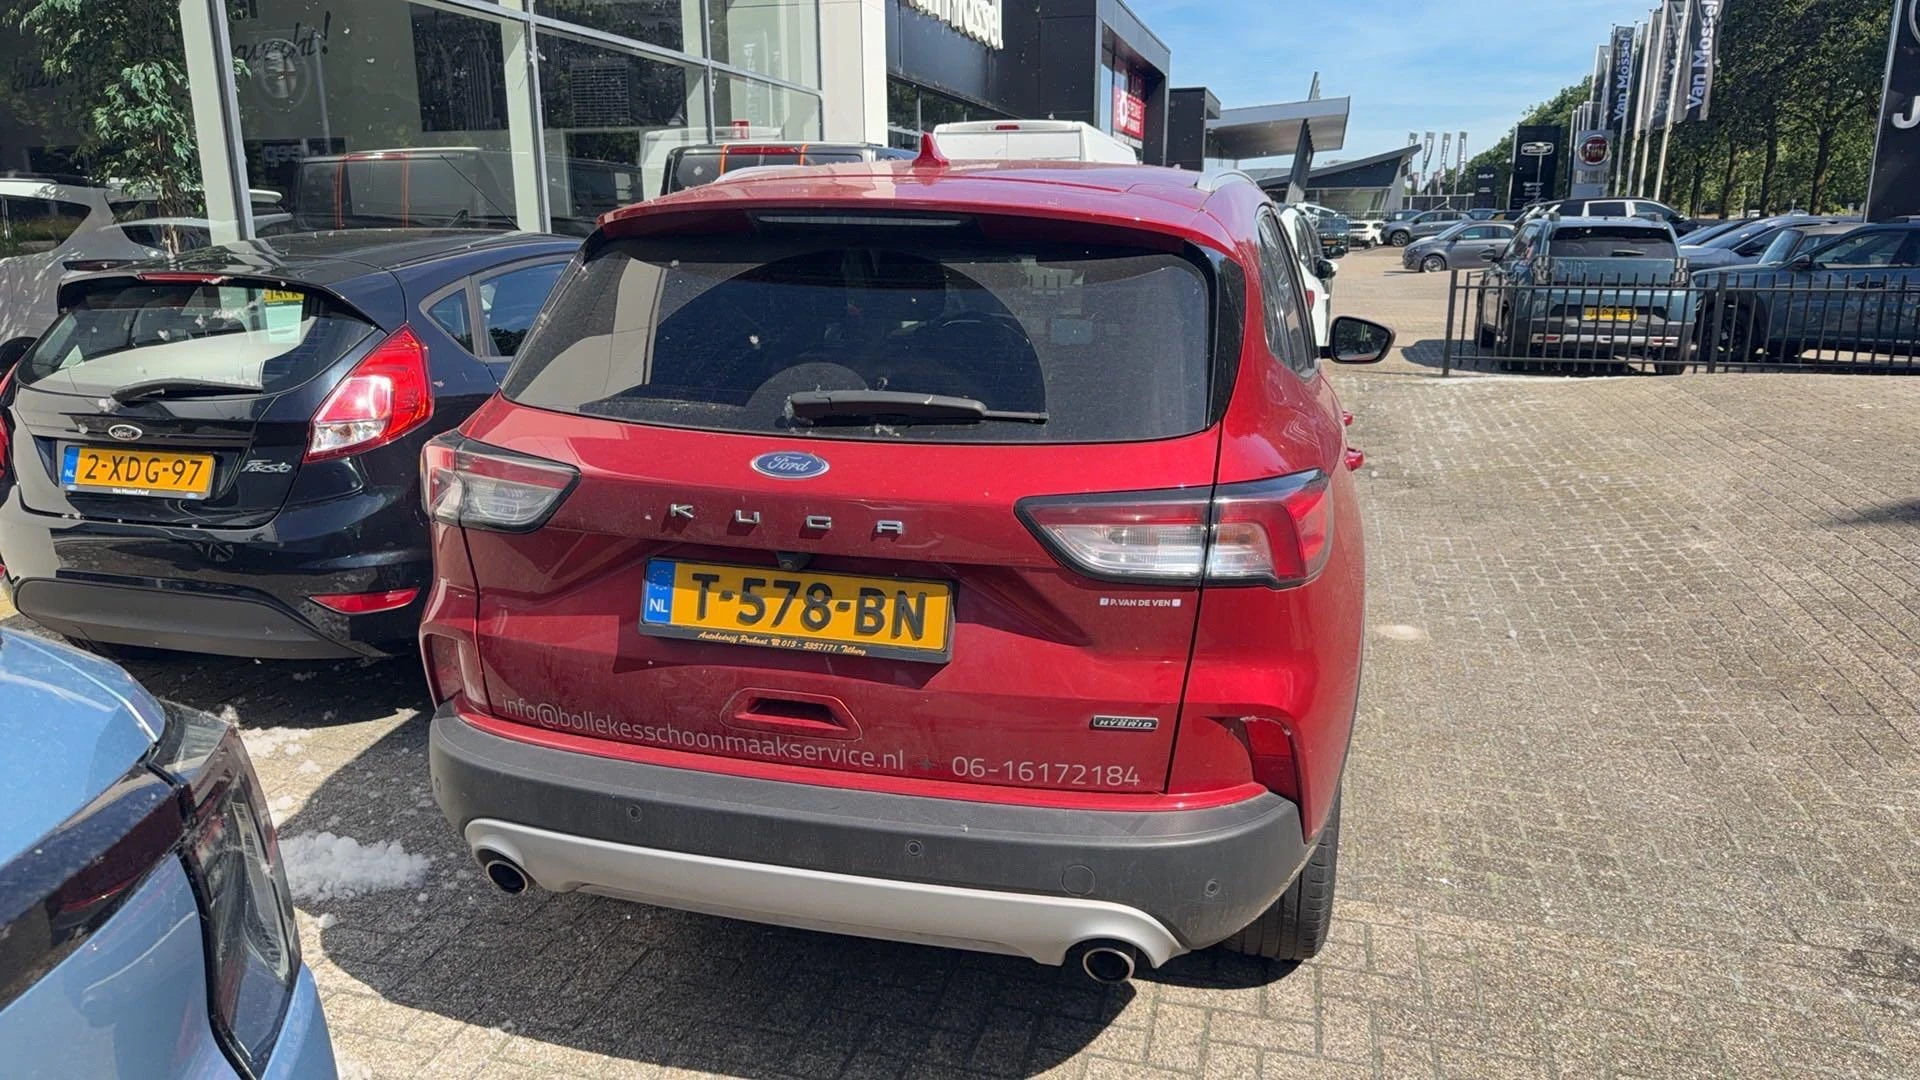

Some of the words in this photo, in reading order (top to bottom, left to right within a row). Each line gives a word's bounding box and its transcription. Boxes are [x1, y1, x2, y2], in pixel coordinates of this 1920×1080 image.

[1692, 0, 1719, 68] Mossel
[1616, 37, 1631, 89] Mossel
[1613, 92, 1627, 121] Van
[1685, 74, 1707, 110] Van
[65, 469, 75, 478] NL
[84, 453, 204, 487] 2-XDG-97
[241, 459, 293, 475] Fiesta
[766, 455, 809, 473] Ford
[670, 503, 904, 535] KUGA
[649, 598, 669, 614] NL
[690, 572, 926, 641] T-578-BN
[781, 640, 797, 649] 013
[503, 698, 905, 771] info@bollekesschoonmaakservice.nl
[1099, 719, 1153, 728] HYBRID
[952, 756, 1141, 788] 06-16172184
